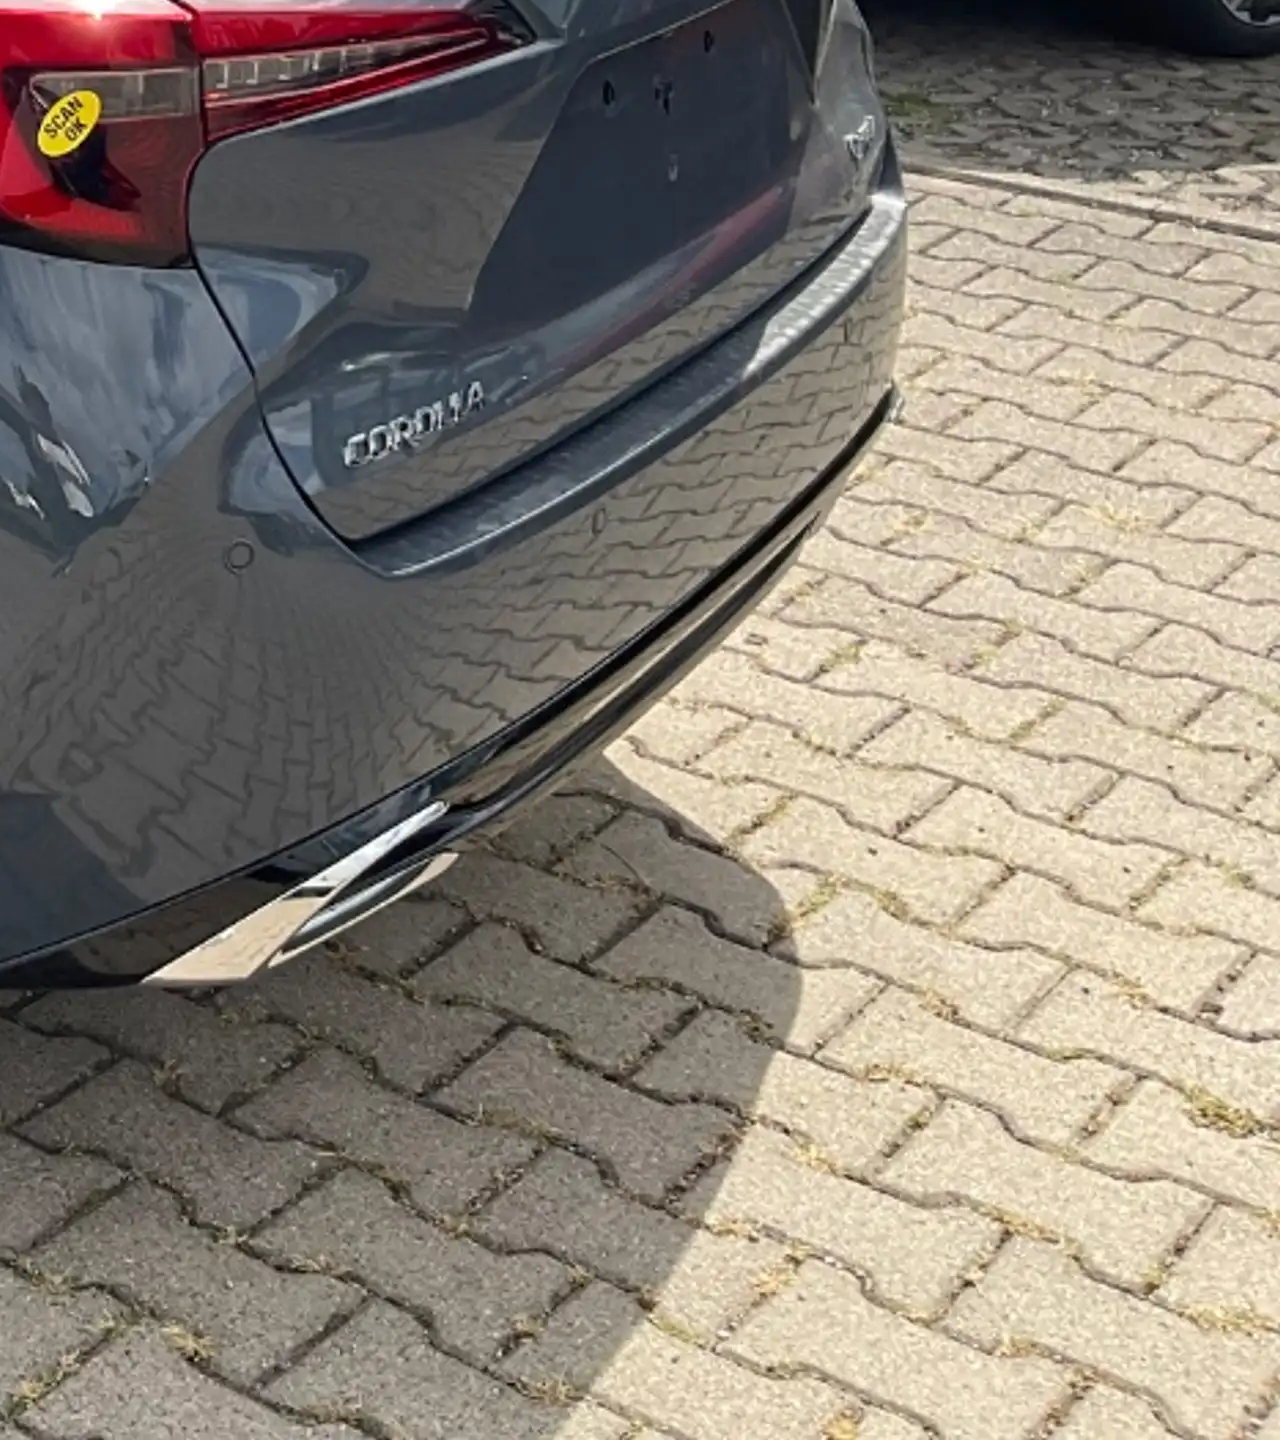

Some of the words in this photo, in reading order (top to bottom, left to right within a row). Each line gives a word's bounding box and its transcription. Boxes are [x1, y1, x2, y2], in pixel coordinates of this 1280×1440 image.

[43, 96, 84, 139] SCAN
[64, 116, 88, 142] OK
[343, 380, 485, 468] COROLLA
